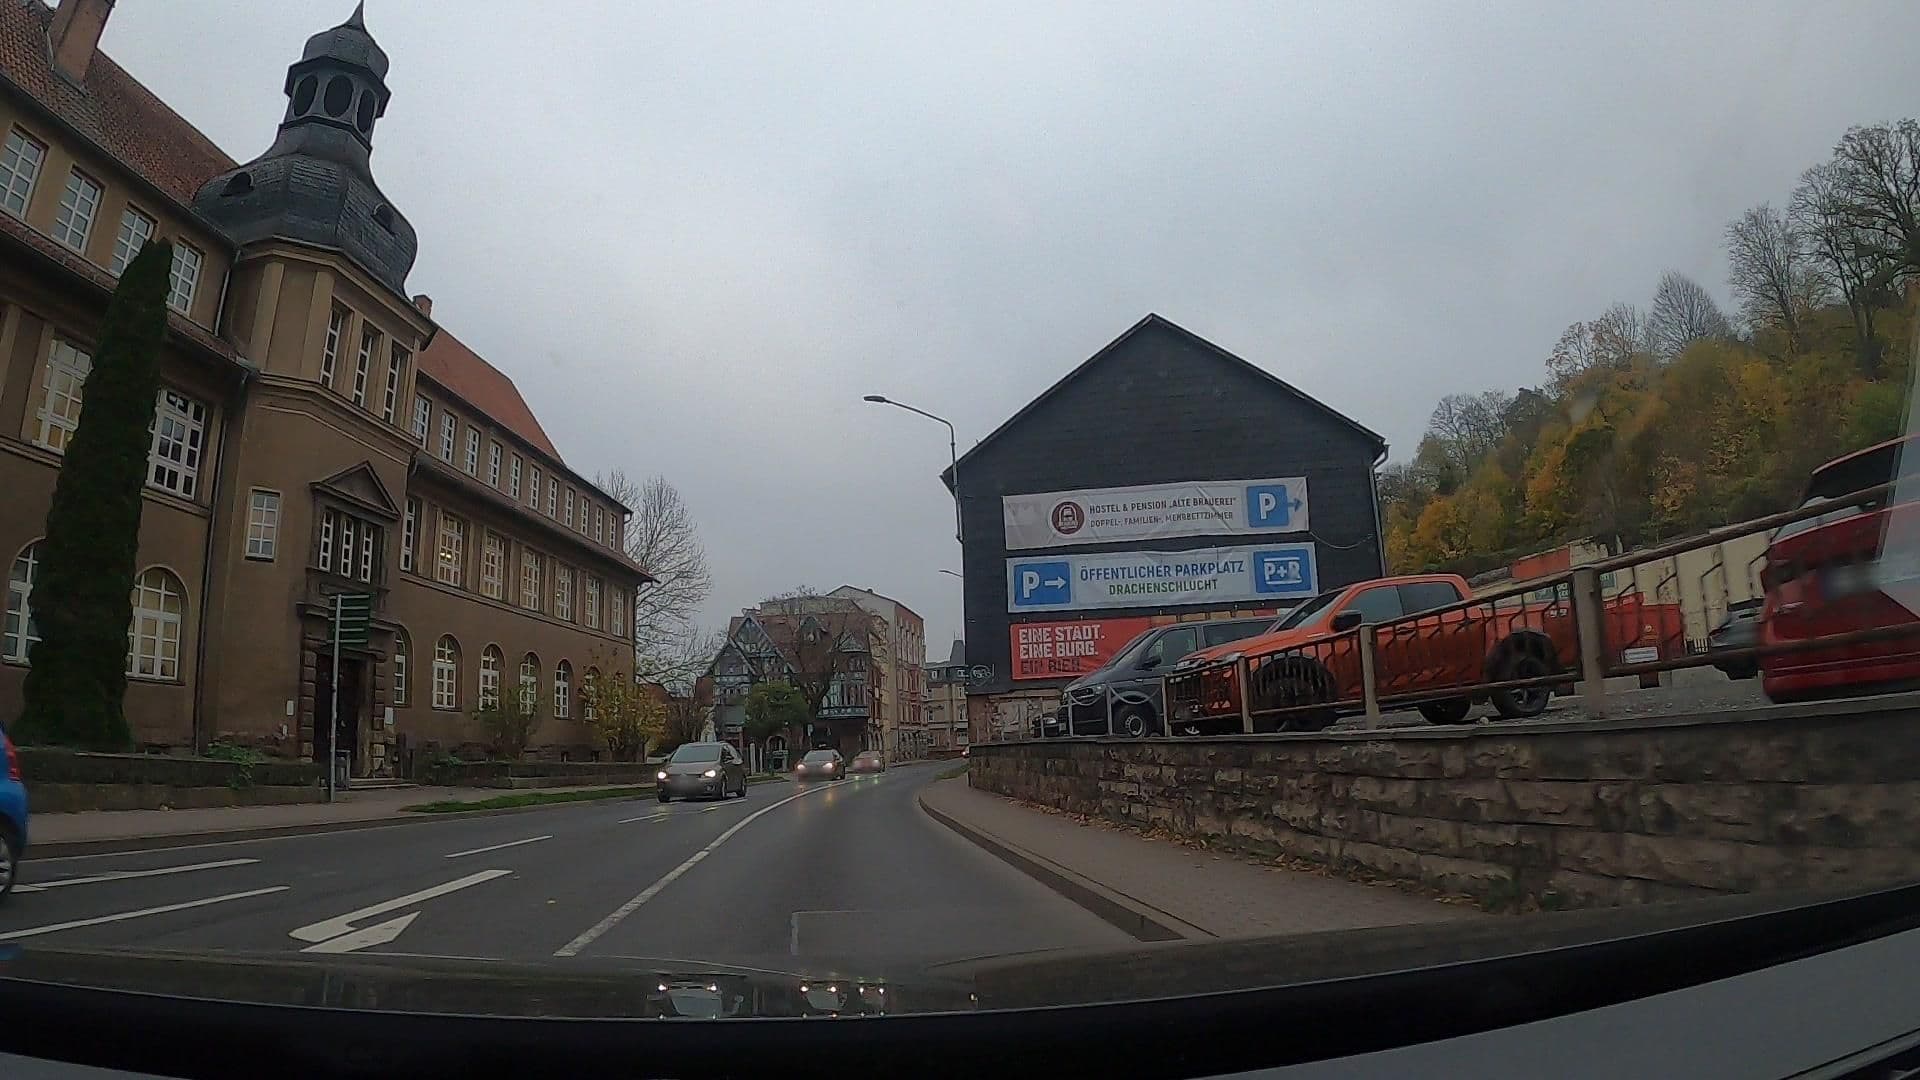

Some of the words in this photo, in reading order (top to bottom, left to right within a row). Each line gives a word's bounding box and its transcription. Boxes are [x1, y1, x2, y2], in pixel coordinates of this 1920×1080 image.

[1089, 504, 1121, 514] HOSTEL
[1122, 503, 1129, 512] &
[1131, 500, 1167, 511] PENSION
[1258, 493, 1276, 520] P
[1080, 564, 1172, 582] ÖFFENTLICHER
[1175, 560, 1244, 577] PARKPLATZ
[1263, 560, 1303, 581] P+R
[1022, 571, 1040, 599] P
[1109, 578, 1218, 595] DRACHENSCHLUCHT
[1019, 627, 1052, 644] EINE
[1055, 624, 1106, 642] STADT.
[1020, 642, 1053, 659] EINE
[1056, 640, 1099, 657] BURG.
